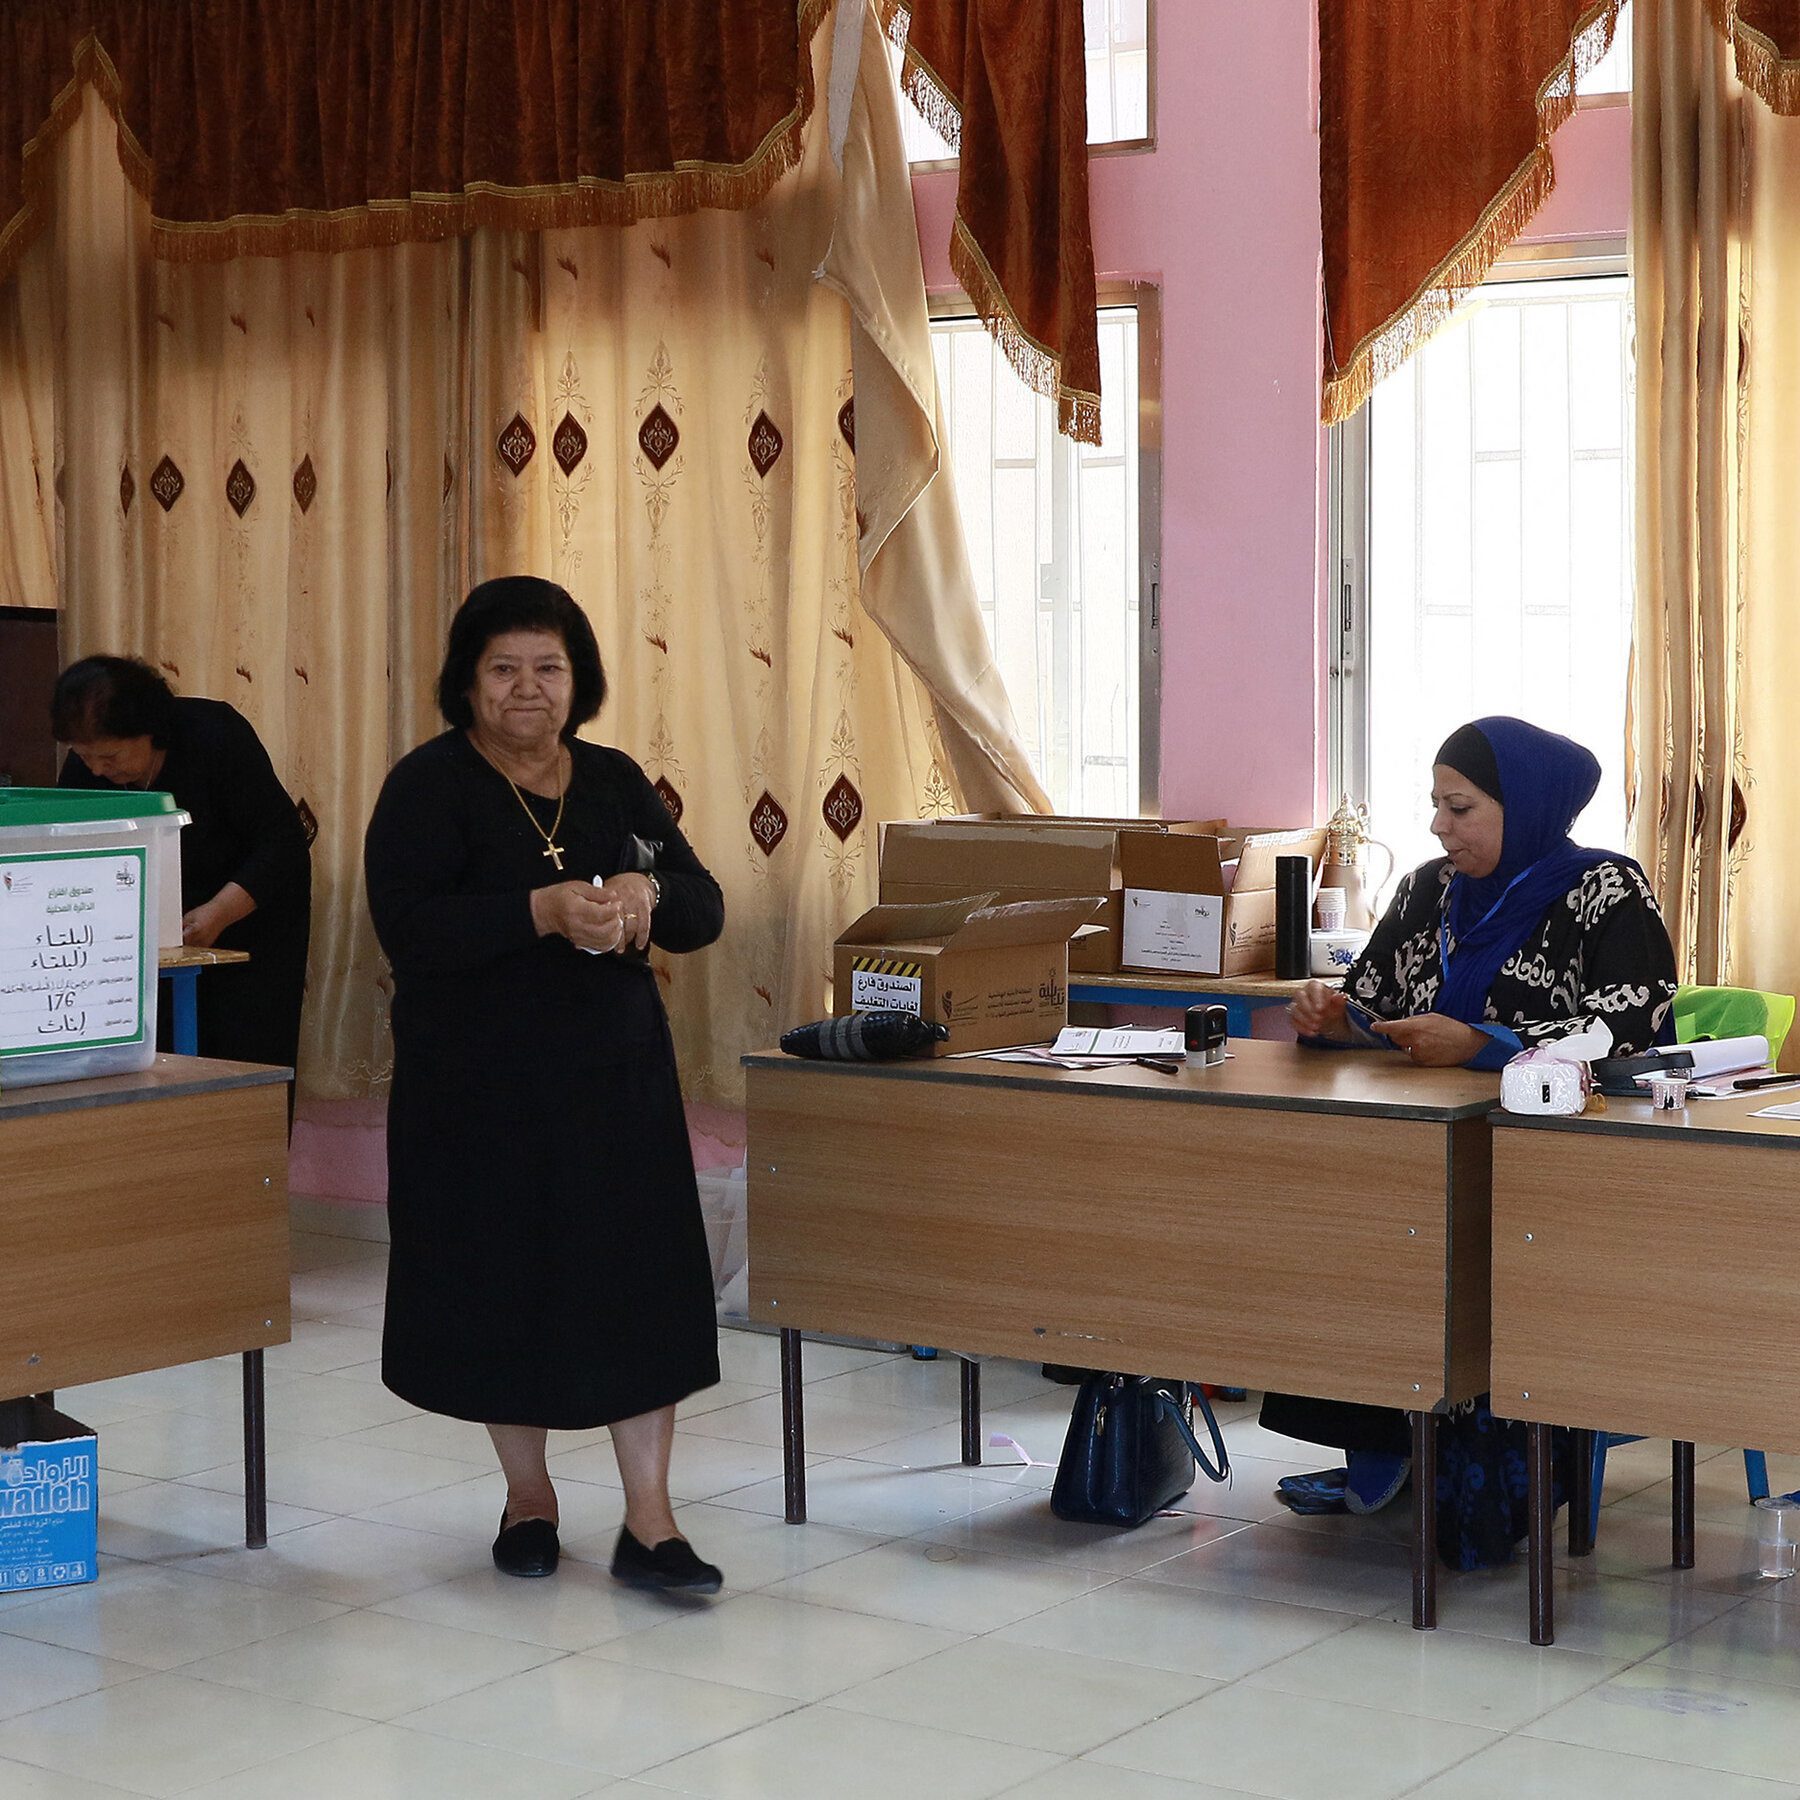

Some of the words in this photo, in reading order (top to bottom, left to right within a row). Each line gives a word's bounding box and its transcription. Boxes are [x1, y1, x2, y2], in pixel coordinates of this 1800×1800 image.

[857, 976, 876, 991] فارغ
[877, 978, 916, 992] الصندوق
[48, 991, 76, 1011] 176
[855, 995, 888, 1009] التغليف
